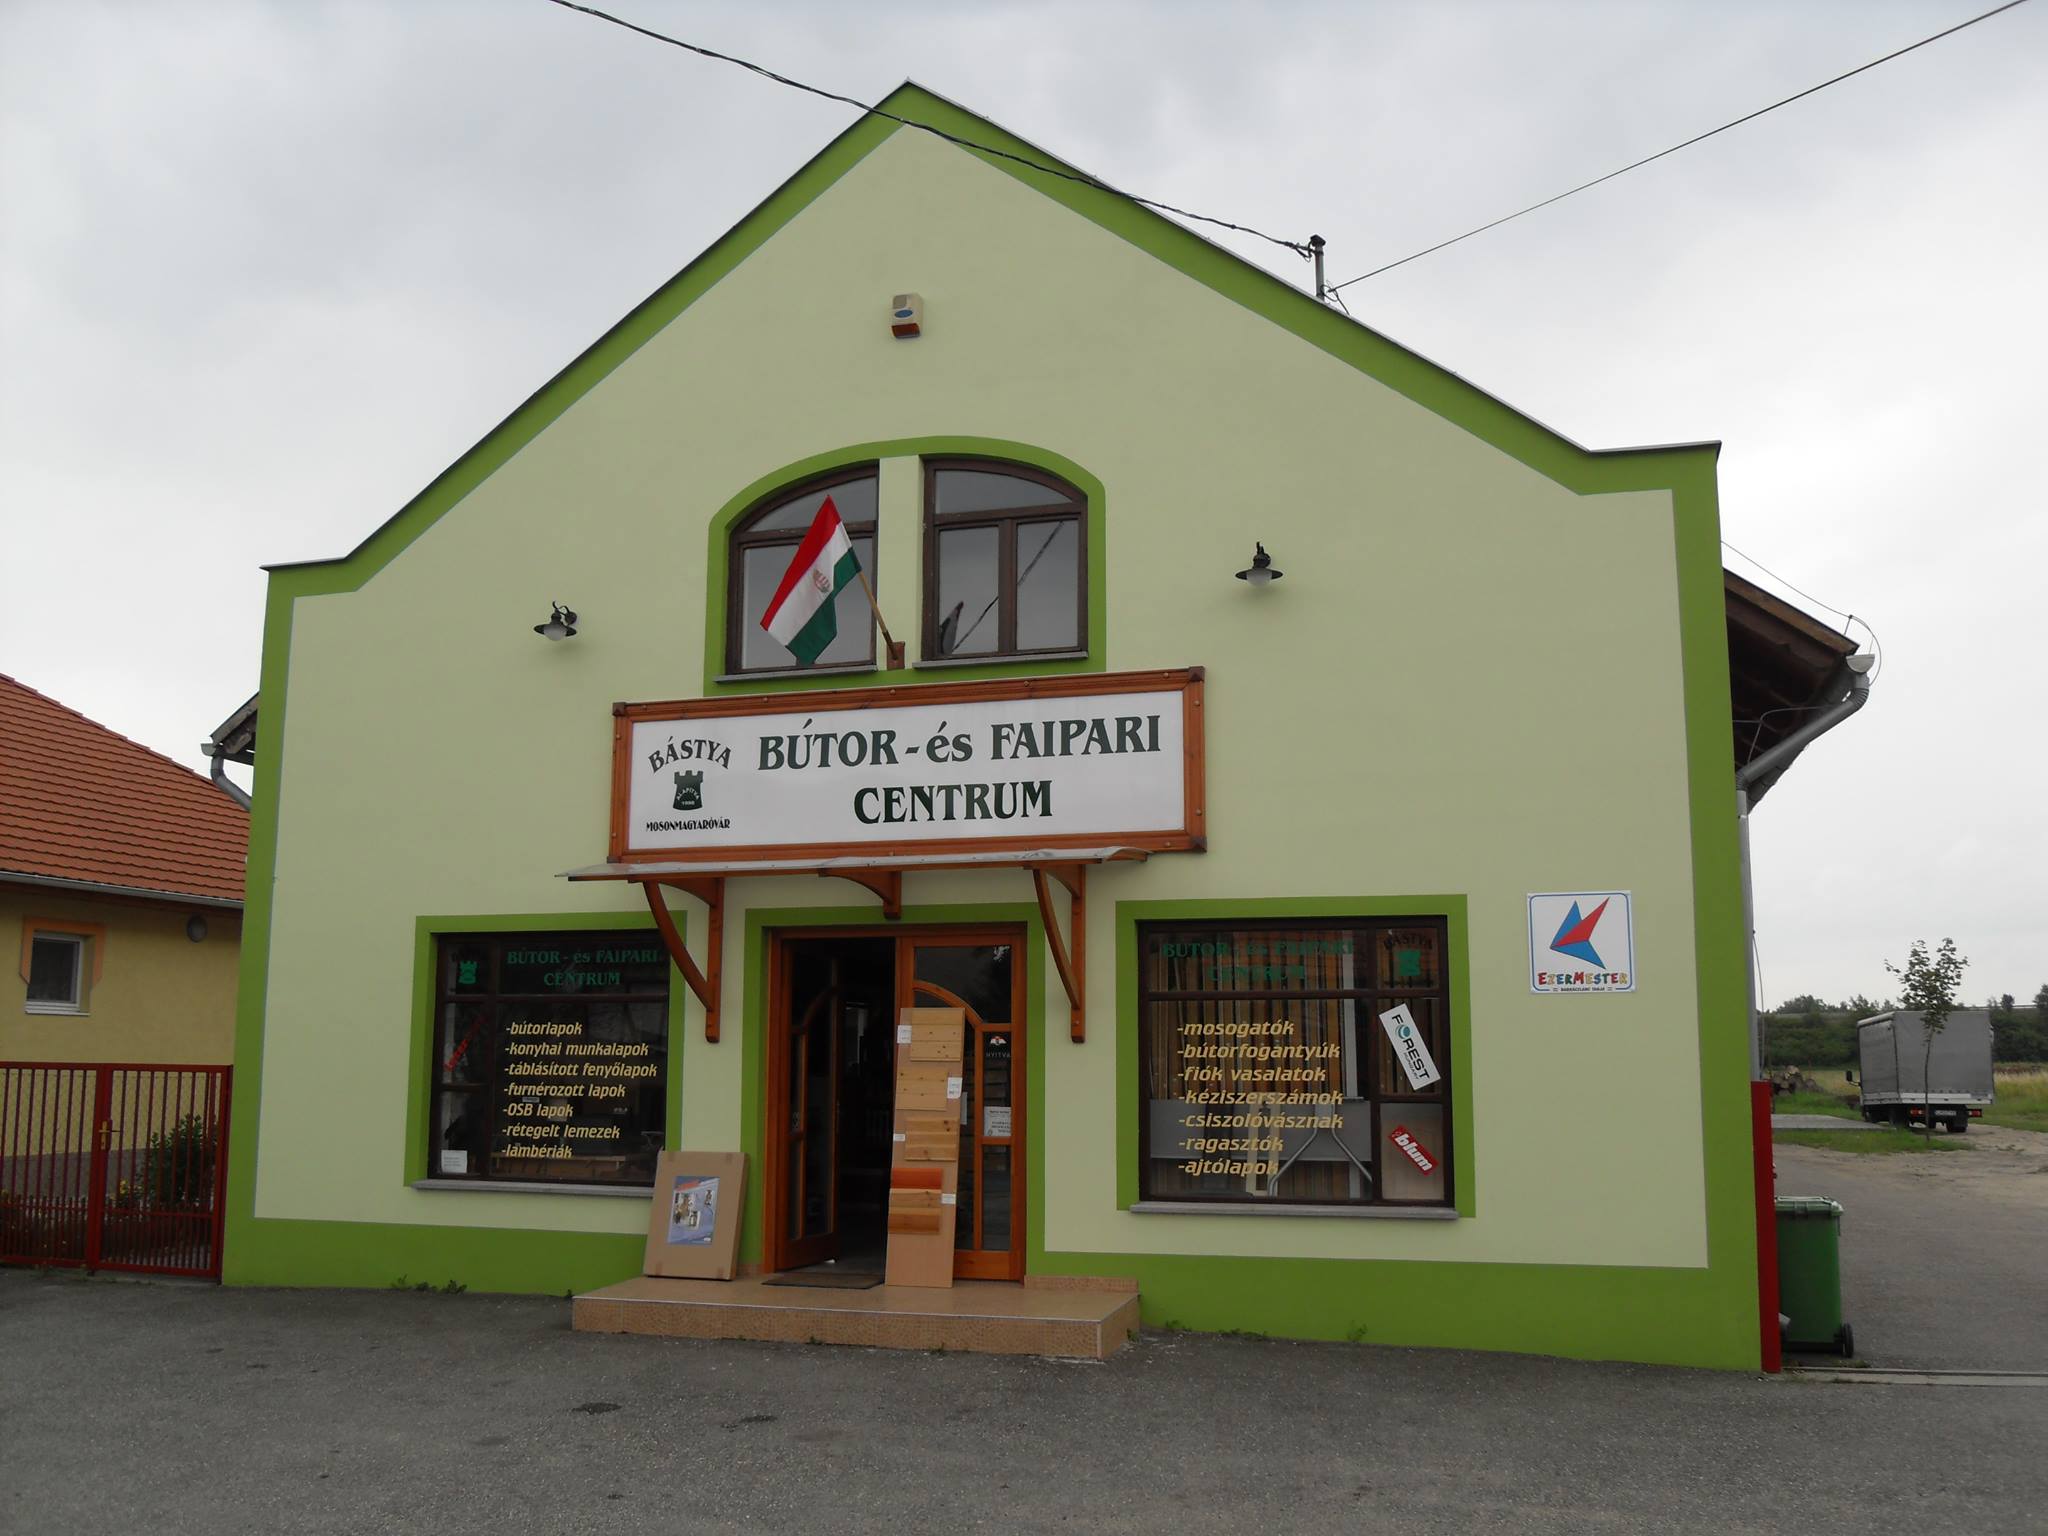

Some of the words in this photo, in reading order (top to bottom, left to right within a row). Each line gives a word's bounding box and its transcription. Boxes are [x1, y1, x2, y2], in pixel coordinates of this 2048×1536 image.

[758, 719, 898, 772] BÚTOR
[926, 720, 973, 763] és
[990, 714, 1161, 761] FAIPARI
[648, 736, 732, 773] BÁSTYA
[853, 780, 1053, 825] CENTRUM
[646, 816, 731, 832] MOSONMAGYARÓVÁR
[543, 970, 621, 987] CENTRUM
[1177, 1019, 1295, 1037] -mosogatók
[566, 1042, 649, 1057] munkalapok
[1391, 1014, 1429, 1080] FOREST
[1231, 1067, 1326, 1082] vasalatok
[589, 1083, 626, 1099] lapok
[536, 1104, 574, 1118] lapok
[564, 1124, 620, 1138] lemezek
[1395, 1133, 1433, 1172] blum
